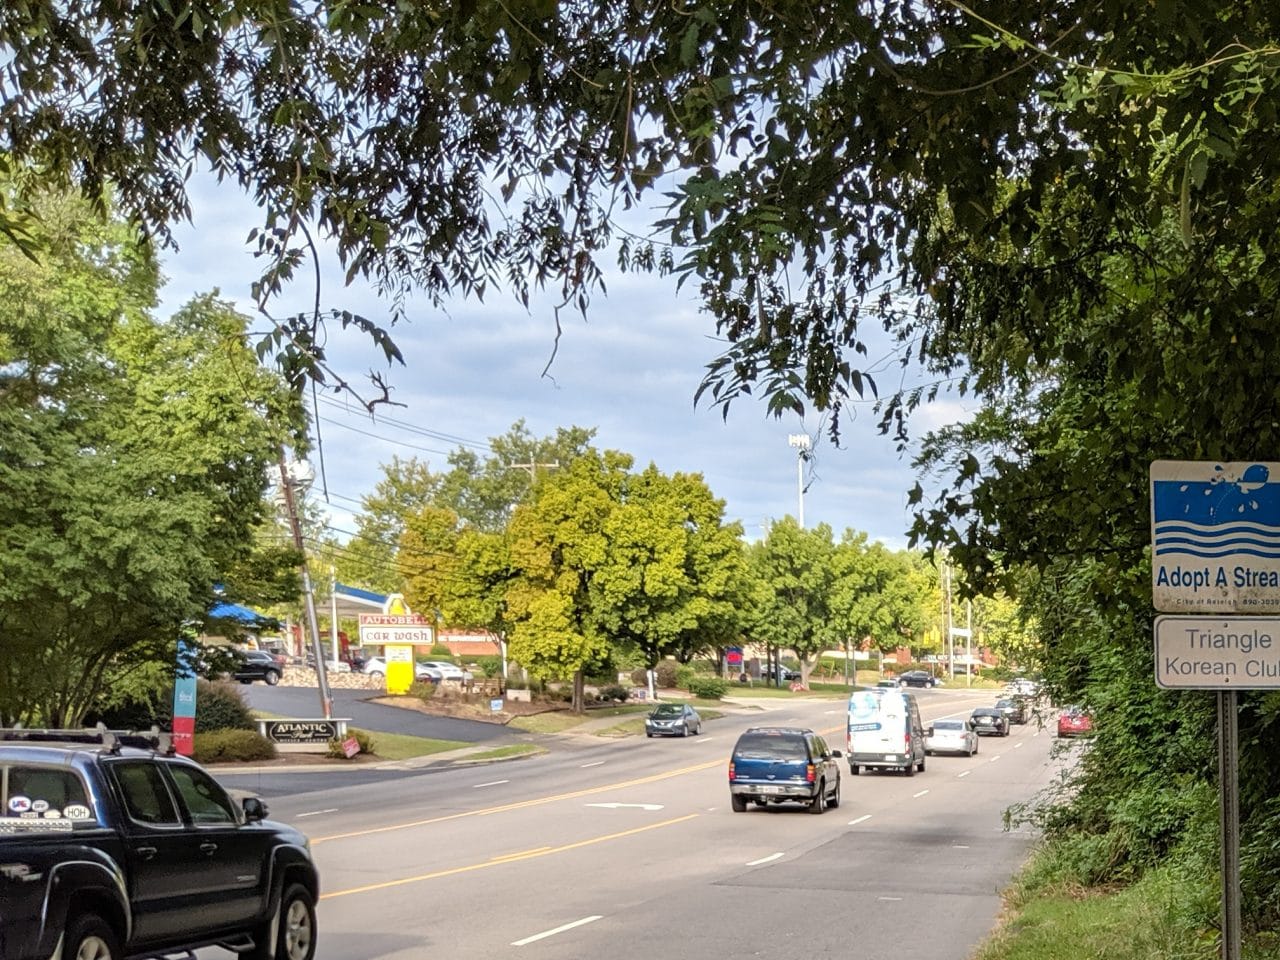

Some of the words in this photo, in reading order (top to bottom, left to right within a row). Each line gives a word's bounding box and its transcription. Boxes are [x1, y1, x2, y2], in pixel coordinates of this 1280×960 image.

[1156, 565, 1210, 593] Adopt
[1214, 566, 1228, 587] A
[1185, 628, 1272, 653] Triangle
[1165, 656, 1237, 675] Korean
[277, 723, 327, 733] ATLANTIC
[68, 807, 86, 817] HOH
